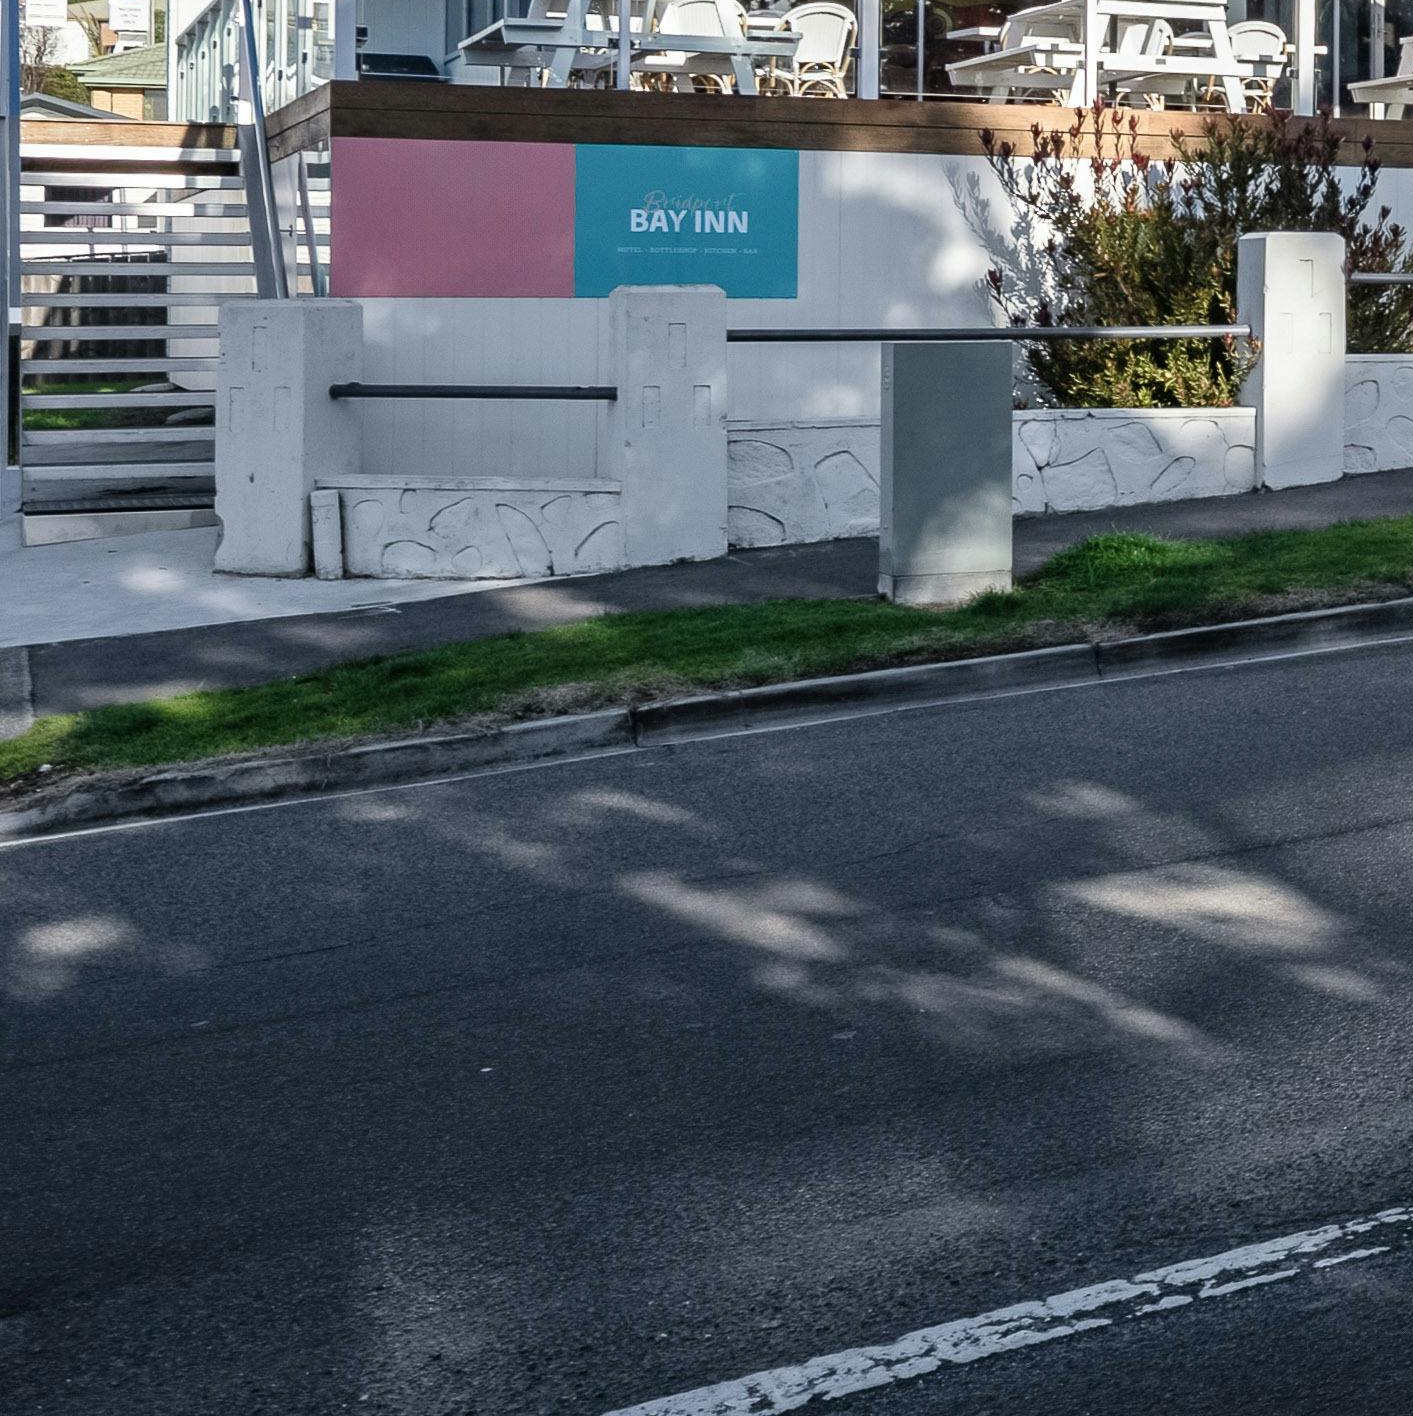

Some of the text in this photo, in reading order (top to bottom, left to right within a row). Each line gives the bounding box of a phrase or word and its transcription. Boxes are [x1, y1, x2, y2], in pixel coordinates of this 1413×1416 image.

[643, 189, 746, 215] Bridport
[630, 208, 748, 234] BAY INN
